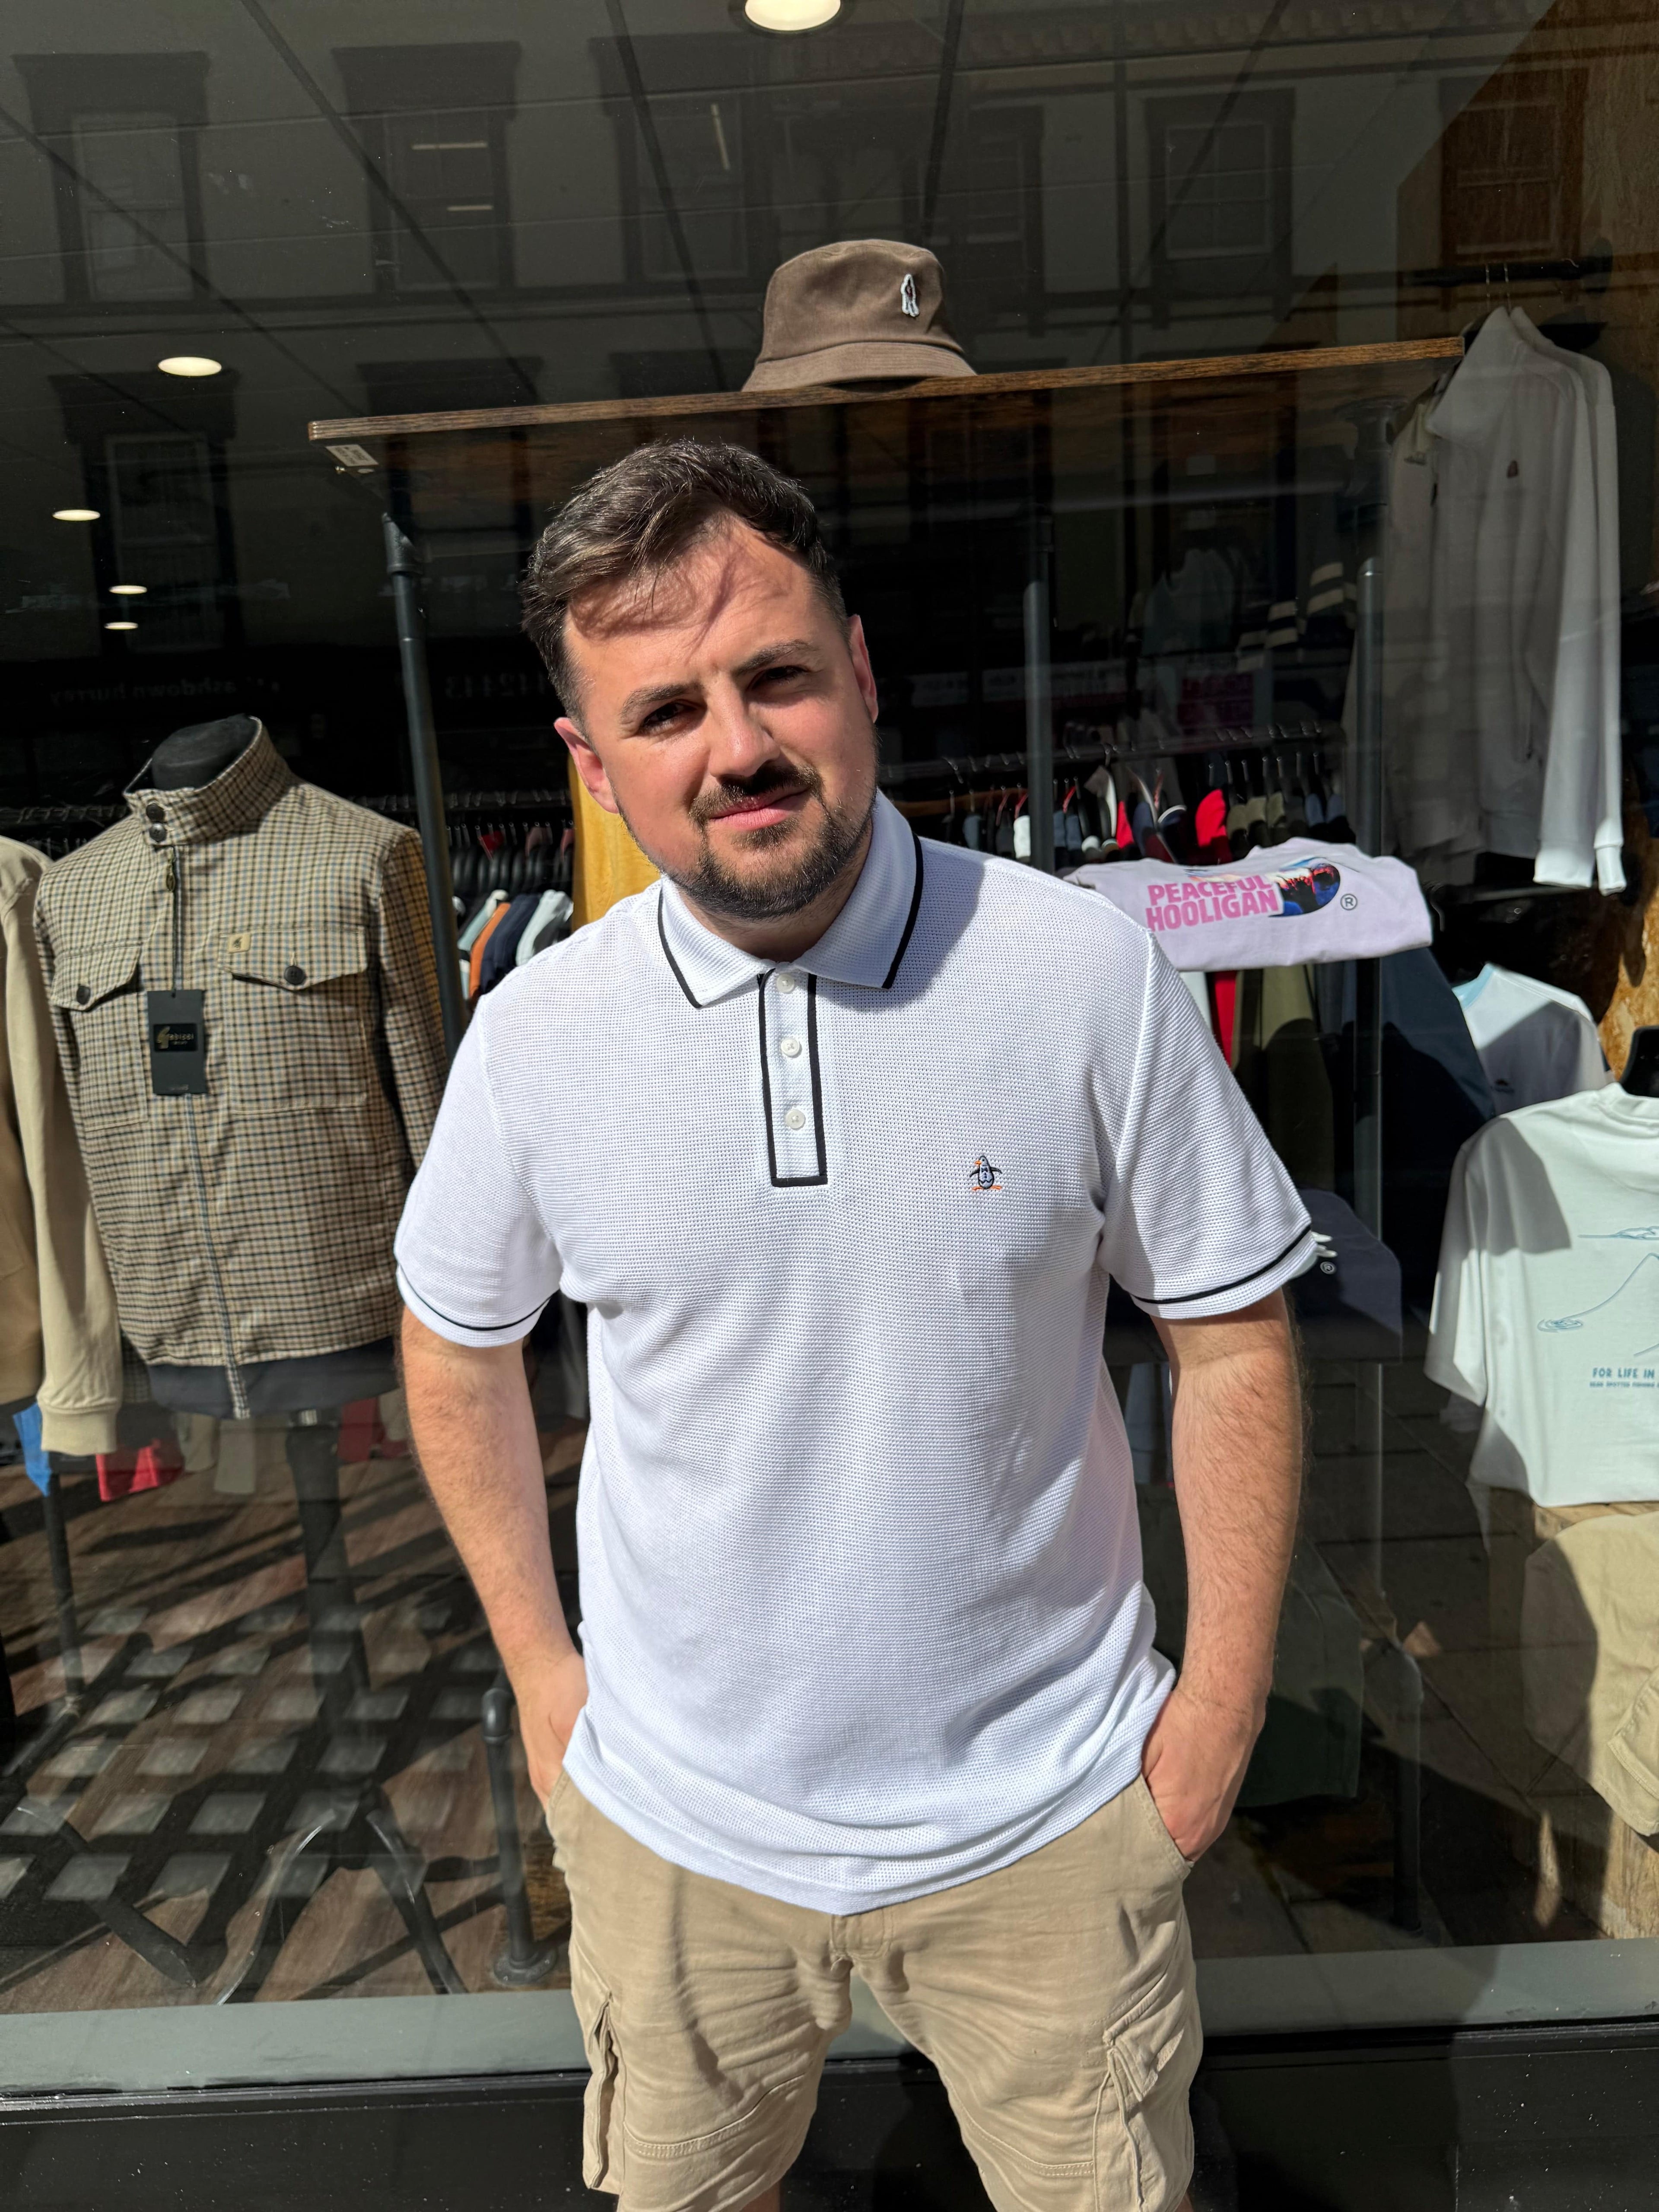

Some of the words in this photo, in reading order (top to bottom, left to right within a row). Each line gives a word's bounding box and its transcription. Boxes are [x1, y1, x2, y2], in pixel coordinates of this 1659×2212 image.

[1147, 874, 1273, 906] PEACEFUL
[1146, 889, 1278, 932] HOOLIGAN
[1592, 1367, 1611, 1378] FOR
[1618, 1367, 1638, 1379] LIFE
[1643, 1368, 1655, 1379] IN
